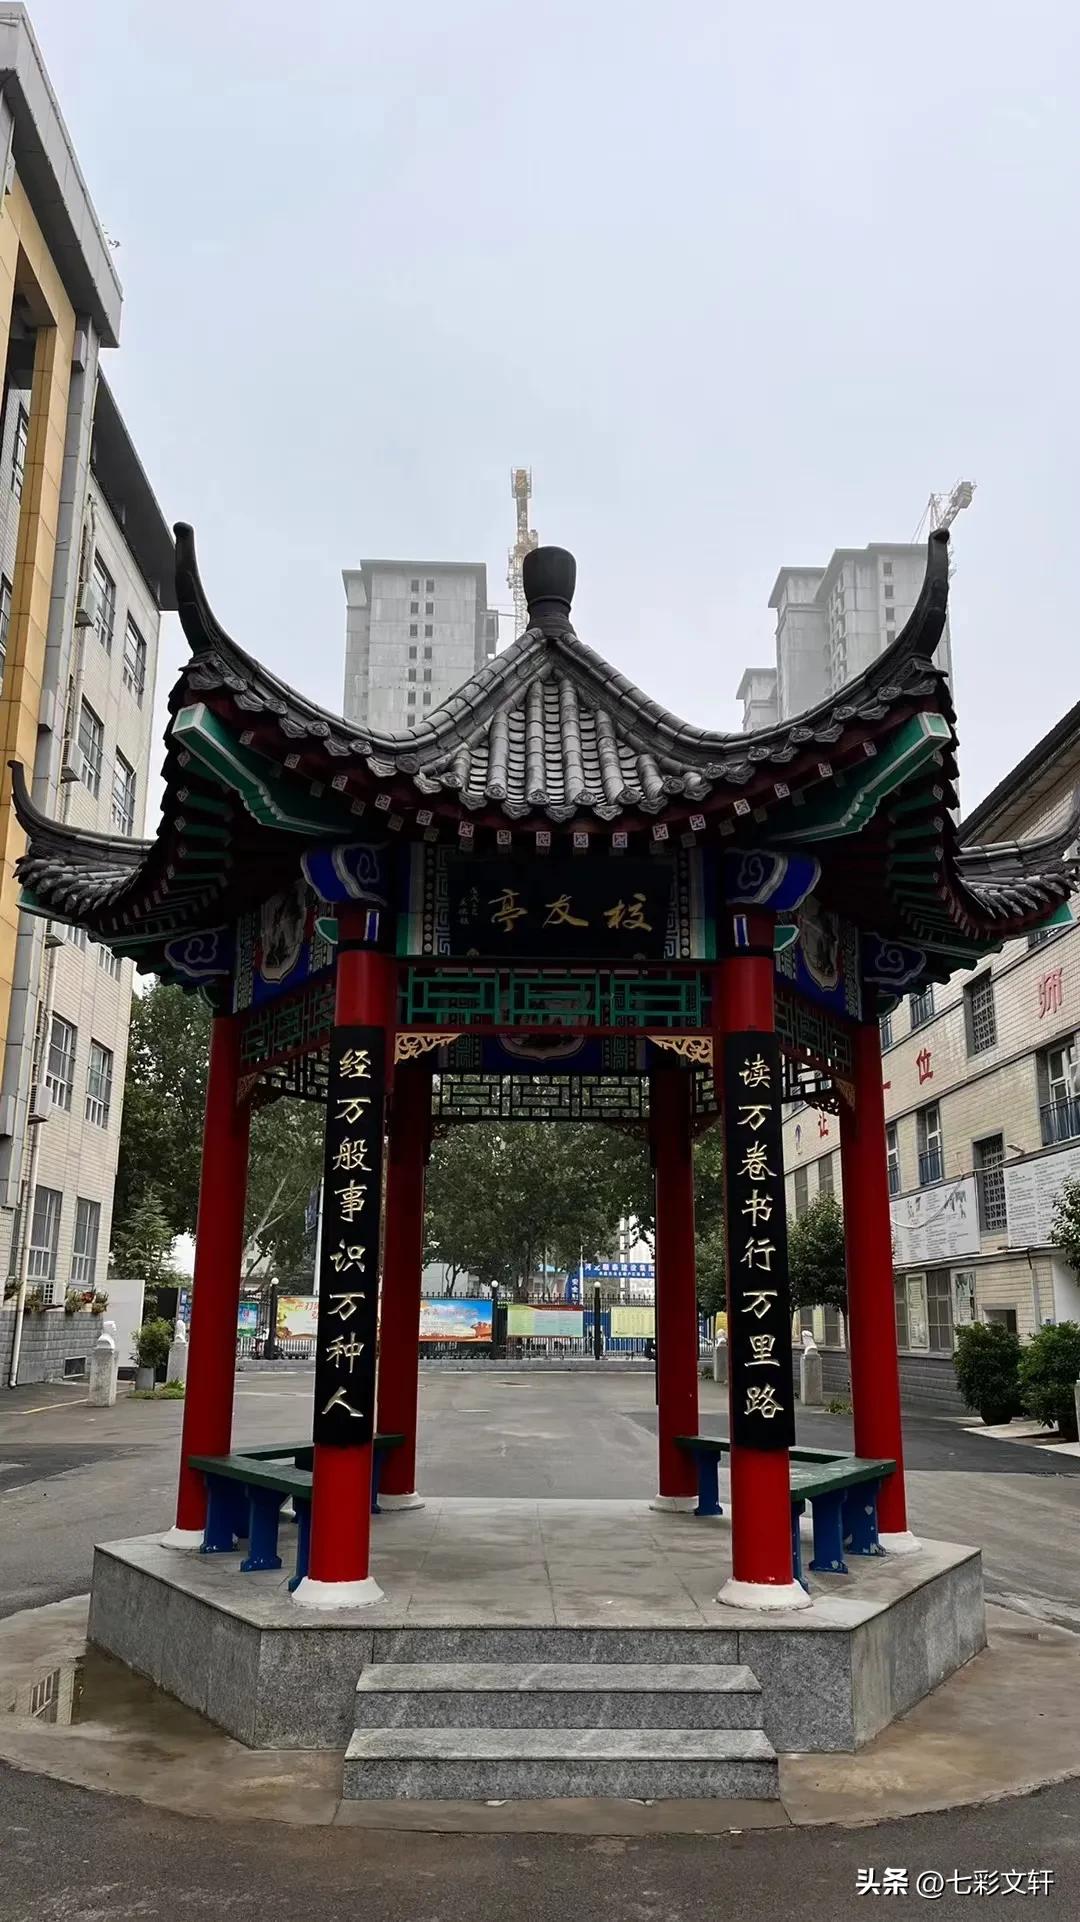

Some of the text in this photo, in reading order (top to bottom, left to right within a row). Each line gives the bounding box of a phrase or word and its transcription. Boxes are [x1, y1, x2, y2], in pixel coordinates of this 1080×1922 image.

[488, 888, 653, 932] 校友亭
[321, 1047, 373, 1418] 经万般事识万种人
[736, 1052, 785, 1420] 读万卷书行万里路
